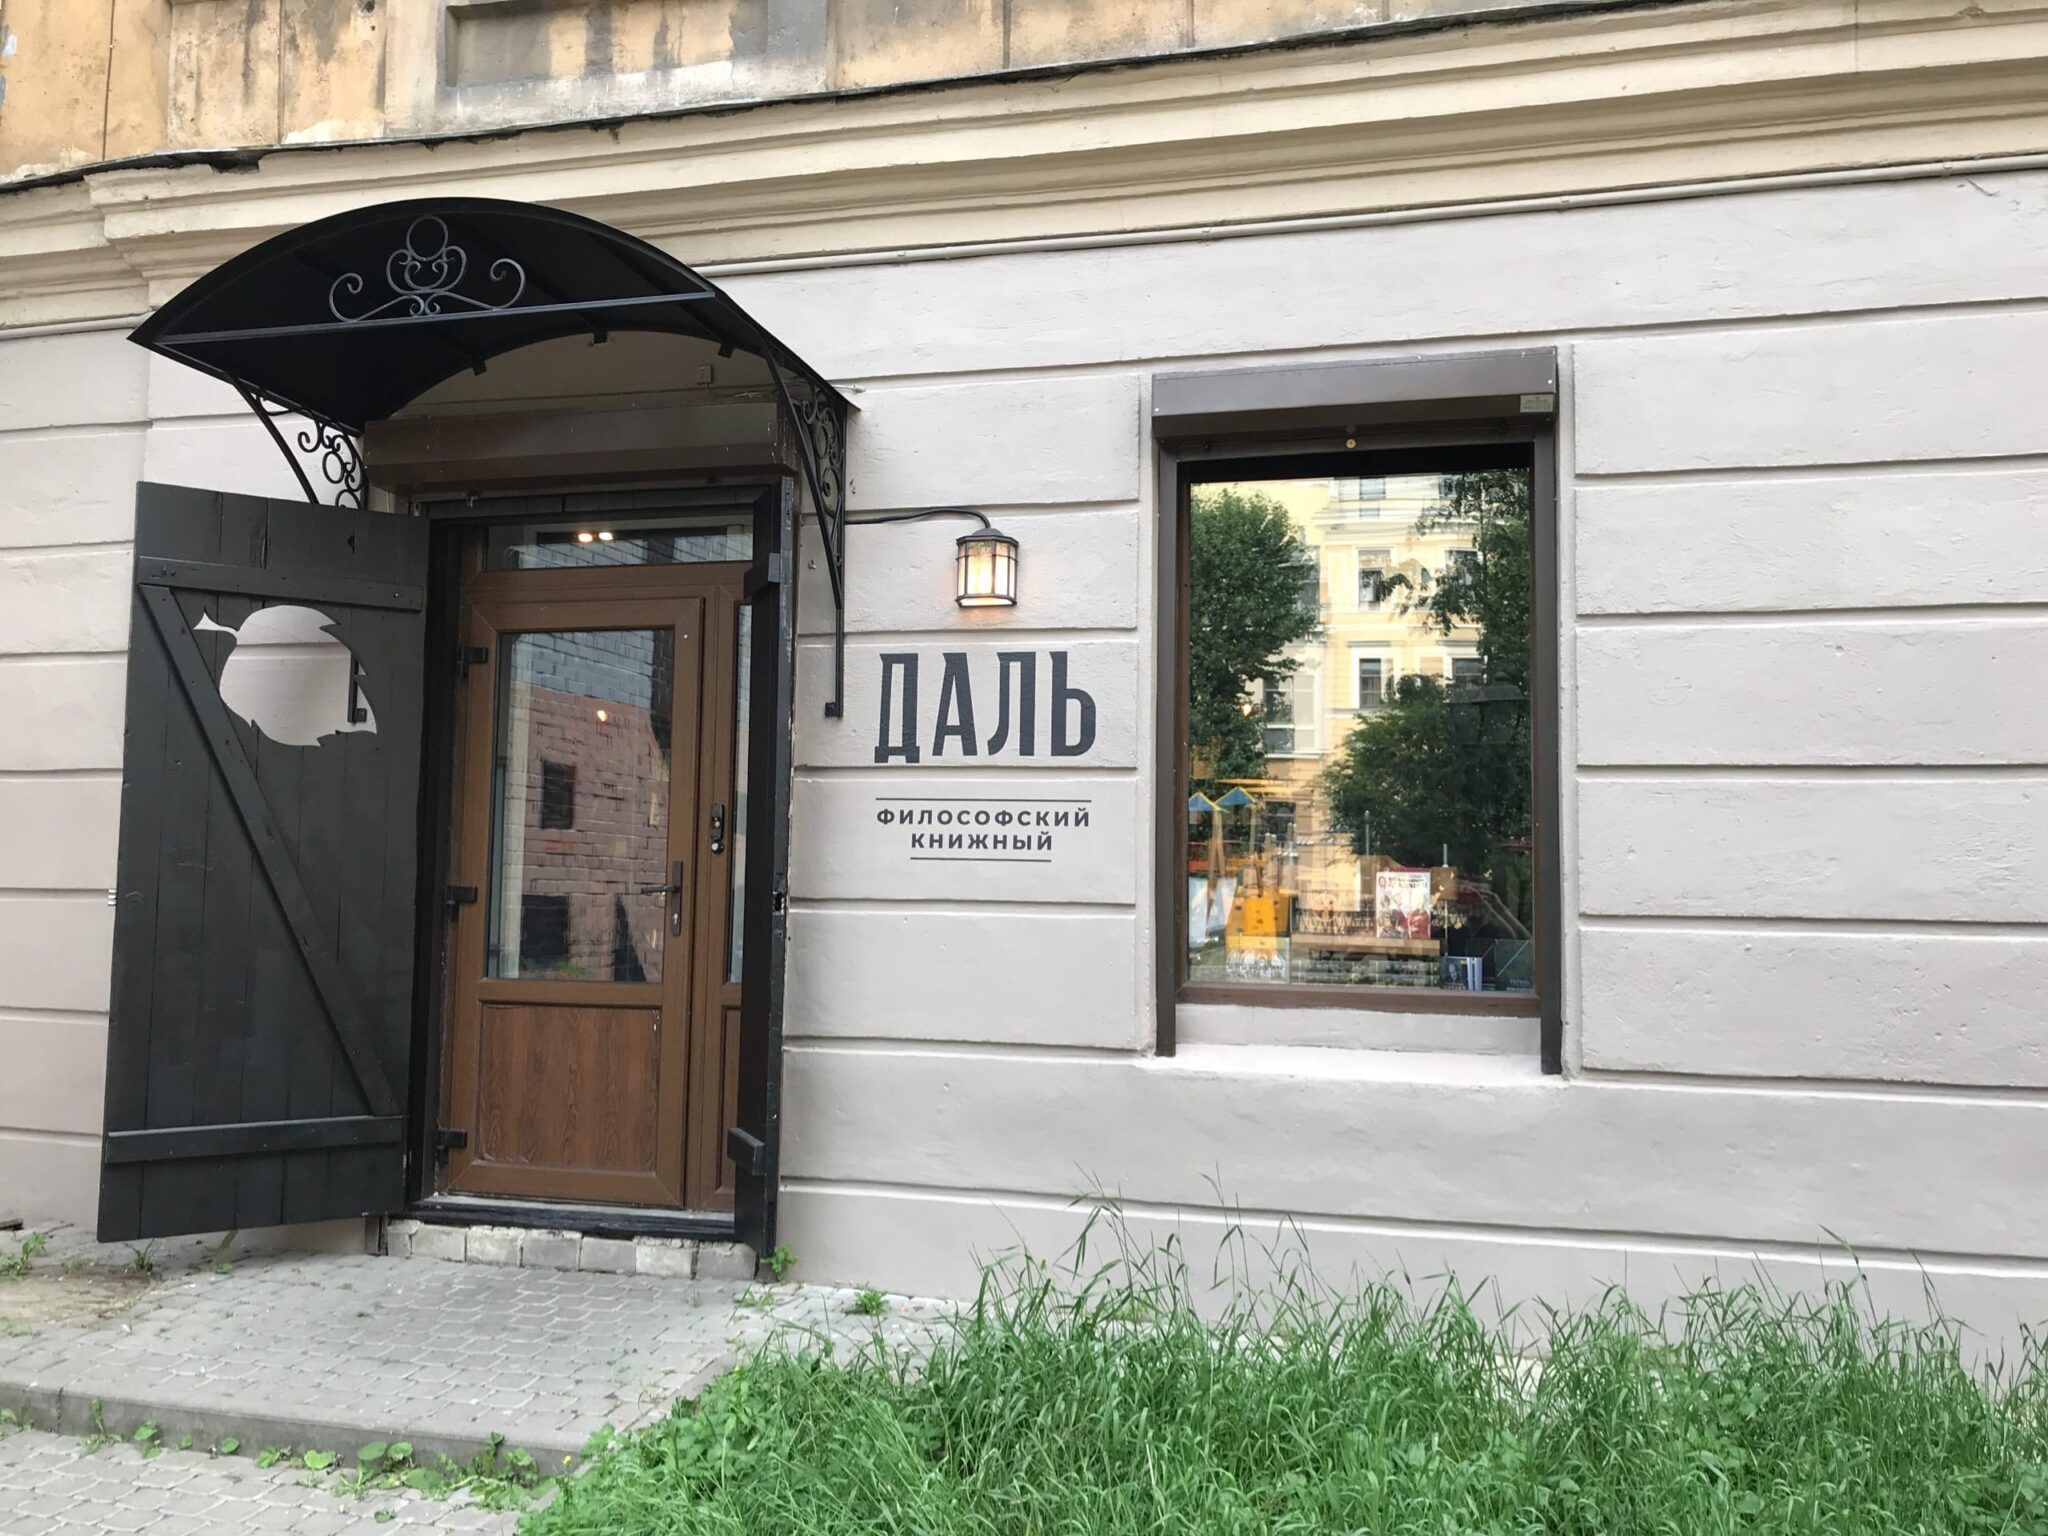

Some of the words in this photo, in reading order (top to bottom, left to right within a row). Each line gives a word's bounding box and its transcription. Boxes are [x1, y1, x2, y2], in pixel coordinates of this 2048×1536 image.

[874, 651, 1096, 763] ДАЛЬ
[876, 807, 1090, 827] ФИЛОСОФСКИЙ
[911, 831, 1052, 851] КНИЖНЫЙ
